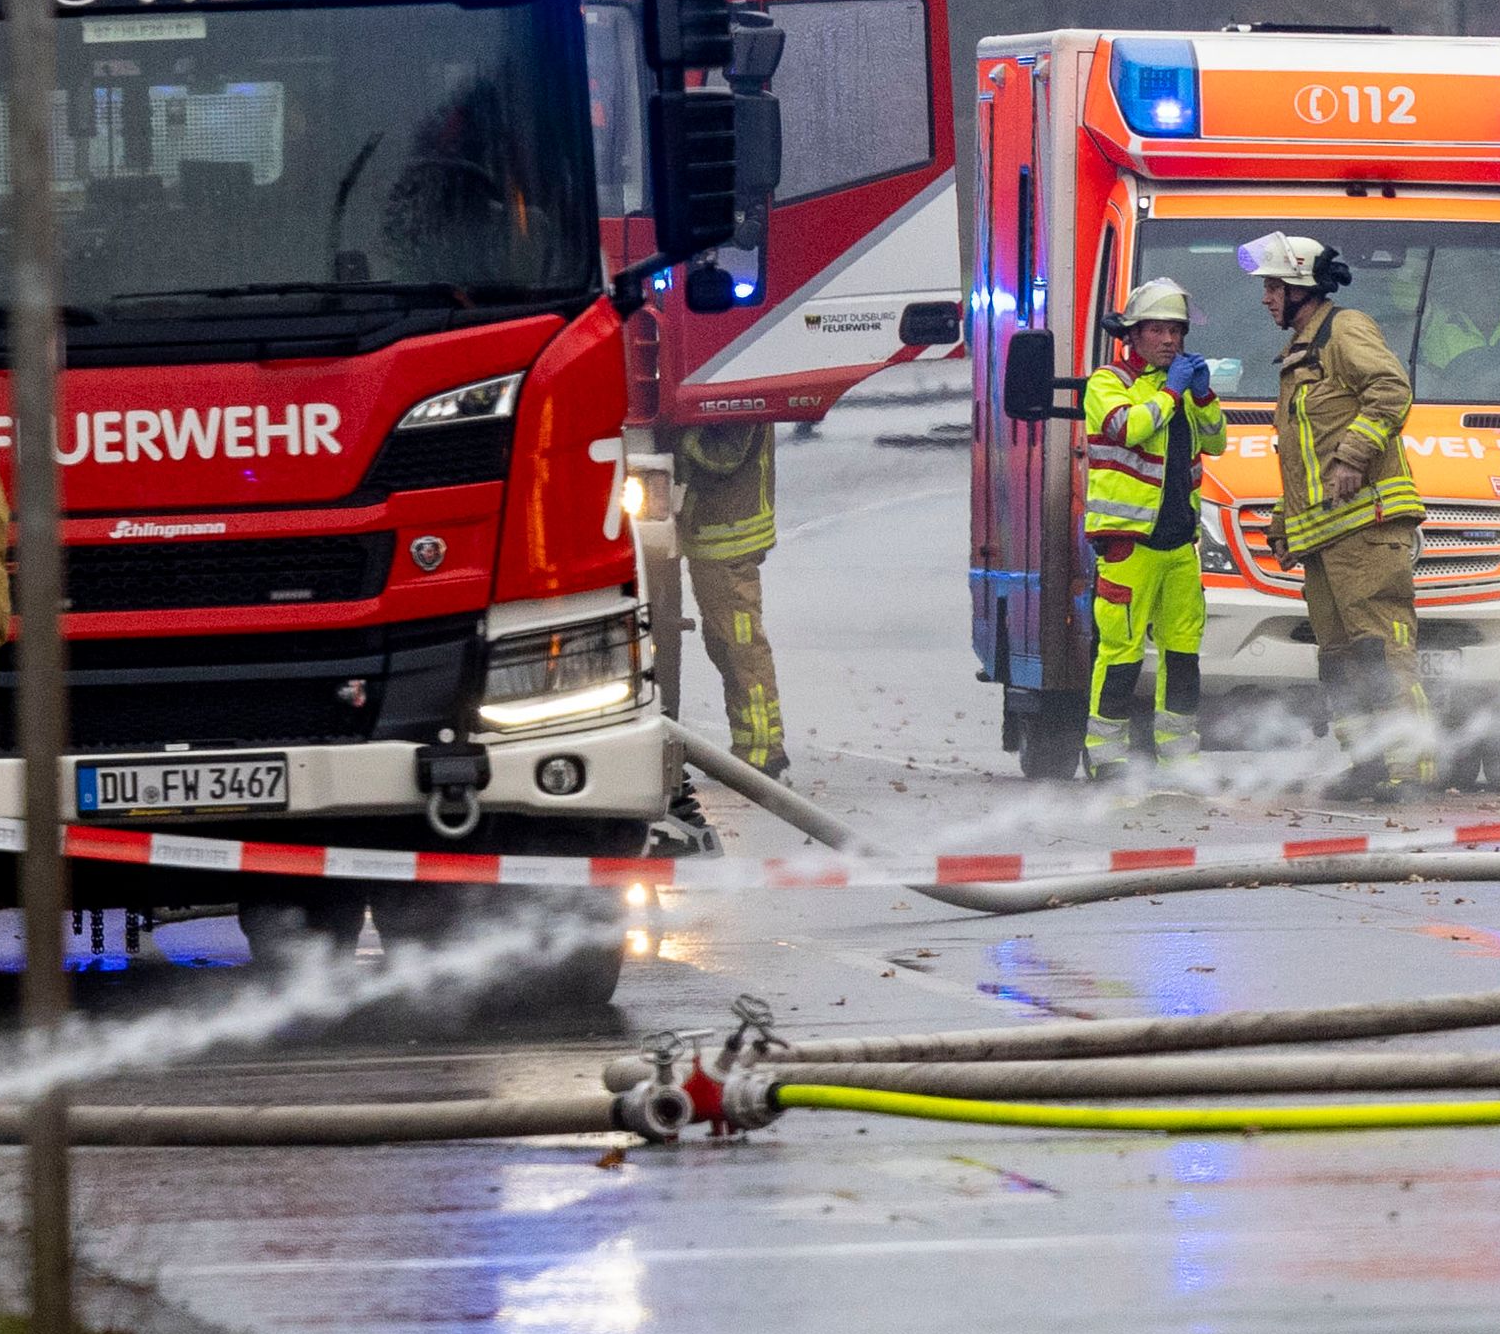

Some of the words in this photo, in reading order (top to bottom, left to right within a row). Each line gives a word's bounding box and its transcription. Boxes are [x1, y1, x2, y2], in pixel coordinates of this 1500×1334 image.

[1341, 85, 1417, 124] 112
[822, 314, 848, 324] STADT
[850, 311, 896, 324] DUISBURG
[822, 322, 882, 333] FEUERWEHR
[109, 521, 227, 539] Schlingmann
[100, 771, 139, 804] DU
[161, 769, 200, 802] FW
[209, 766, 283, 800] 3467
